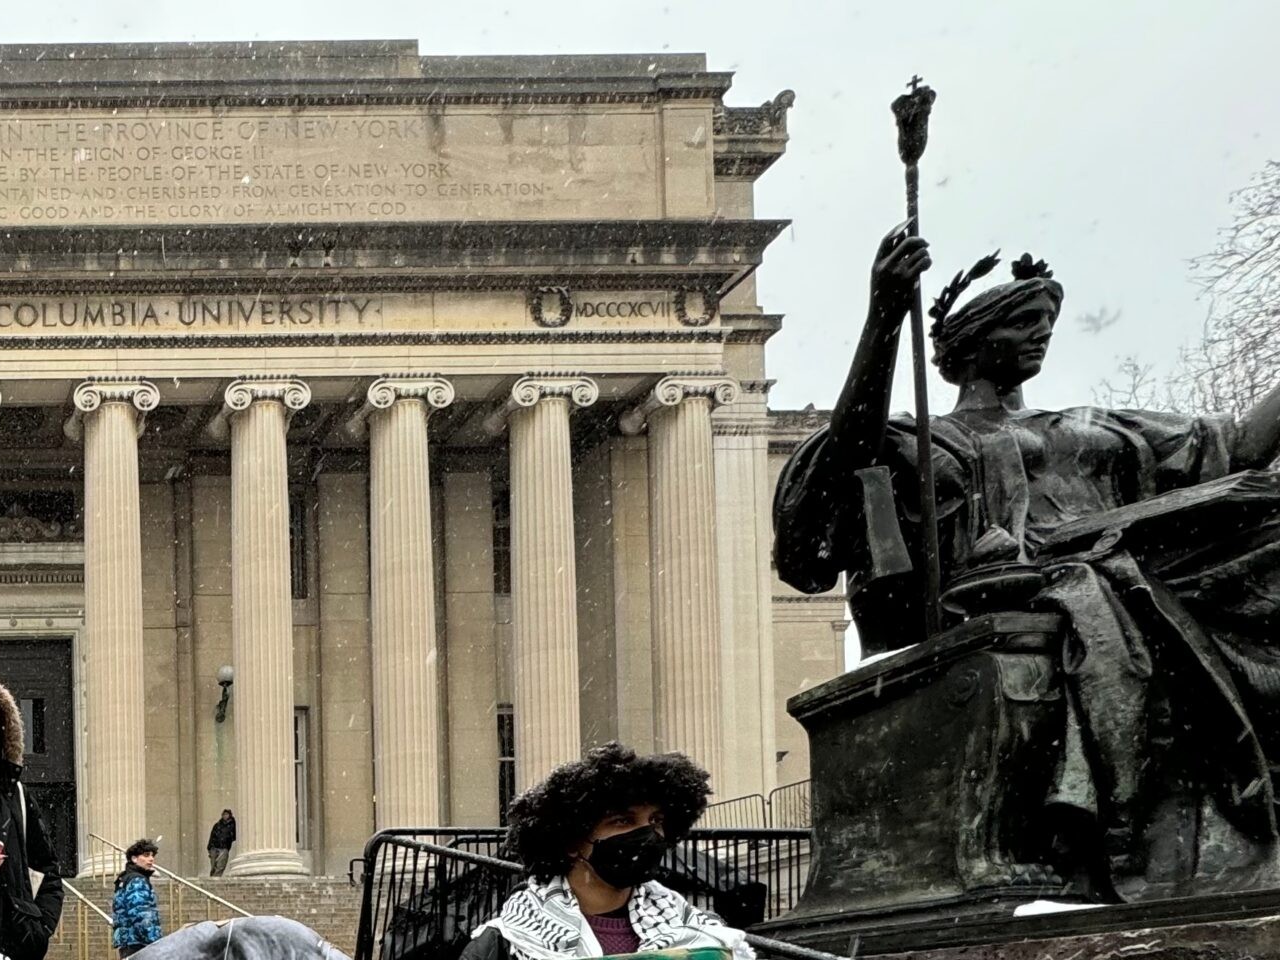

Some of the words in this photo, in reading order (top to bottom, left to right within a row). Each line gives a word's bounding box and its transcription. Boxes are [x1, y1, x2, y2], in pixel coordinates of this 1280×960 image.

[36, 123, 86, 142] THE
[101, 121, 224, 141] PROVINCE
[237, 121, 271, 140] OF
[284, 120, 339, 140] NEW
[351, 119, 419, 139] YORK
[25, 147, 58, 162] THE
[71, 146, 125, 161] REIGN
[136, 146, 163, 160] OF
[170, 145, 243, 160] GEORGE
[20, 167, 42, 182] BY
[49, 166, 87, 182] THE
[97, 165, 163, 181] PEOPLE
[170, 165, 197, 180] OF
[204, 164, 242, 180] THE
[251, 164, 305, 179] STATE
[313, 164, 339, 179] OF
[347, 163, 389, 178] NEW
[400, 162, 453, 178] YORK
[80, 186, 116, 200] AND
[126, 185, 221, 199] CHERISHED
[232, 184, 278, 198] FROM
[406, 183, 428, 197] TO
[436, 182, 545, 197] GENERATION
[19, 206, 70, 220] GOOD
[78, 205, 114, 218] AND
[126, 204, 157, 218] THE
[168, 204, 223, 218] GLORY
[232, 203, 255, 217] OF
[264, 202, 358, 217] ALMIGHTY
[367, 202, 407, 216] GOD
[176, 299, 372, 326] UNIVERSITY
[575, 301, 670, 318] MDCCCXCVII
